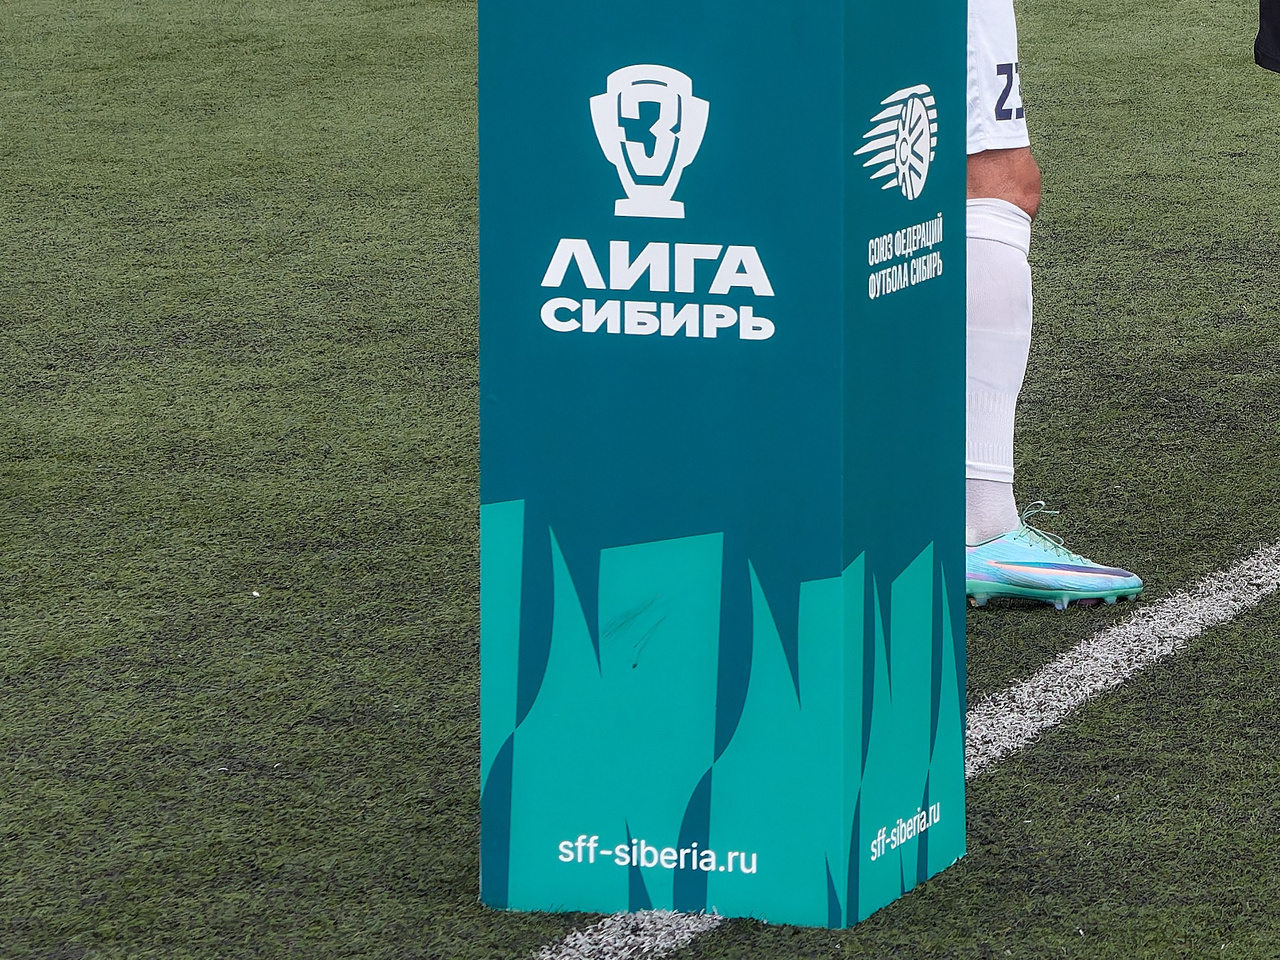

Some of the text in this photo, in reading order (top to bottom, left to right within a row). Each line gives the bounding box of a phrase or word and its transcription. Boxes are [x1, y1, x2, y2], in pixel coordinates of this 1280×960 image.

[868, 212, 943, 266] СОЮЗ ФЕДЕРАЦИЙ
[540, 238, 775, 297] ЛИГА
[868, 251, 943, 300] ФУТБОЛА СИБИРЬ
[540, 297, 775, 340] СИБИРЬ
[558, 834, 758, 875] sff-siberia.ru
[870, 802, 941, 862] sff-siberia.ru
